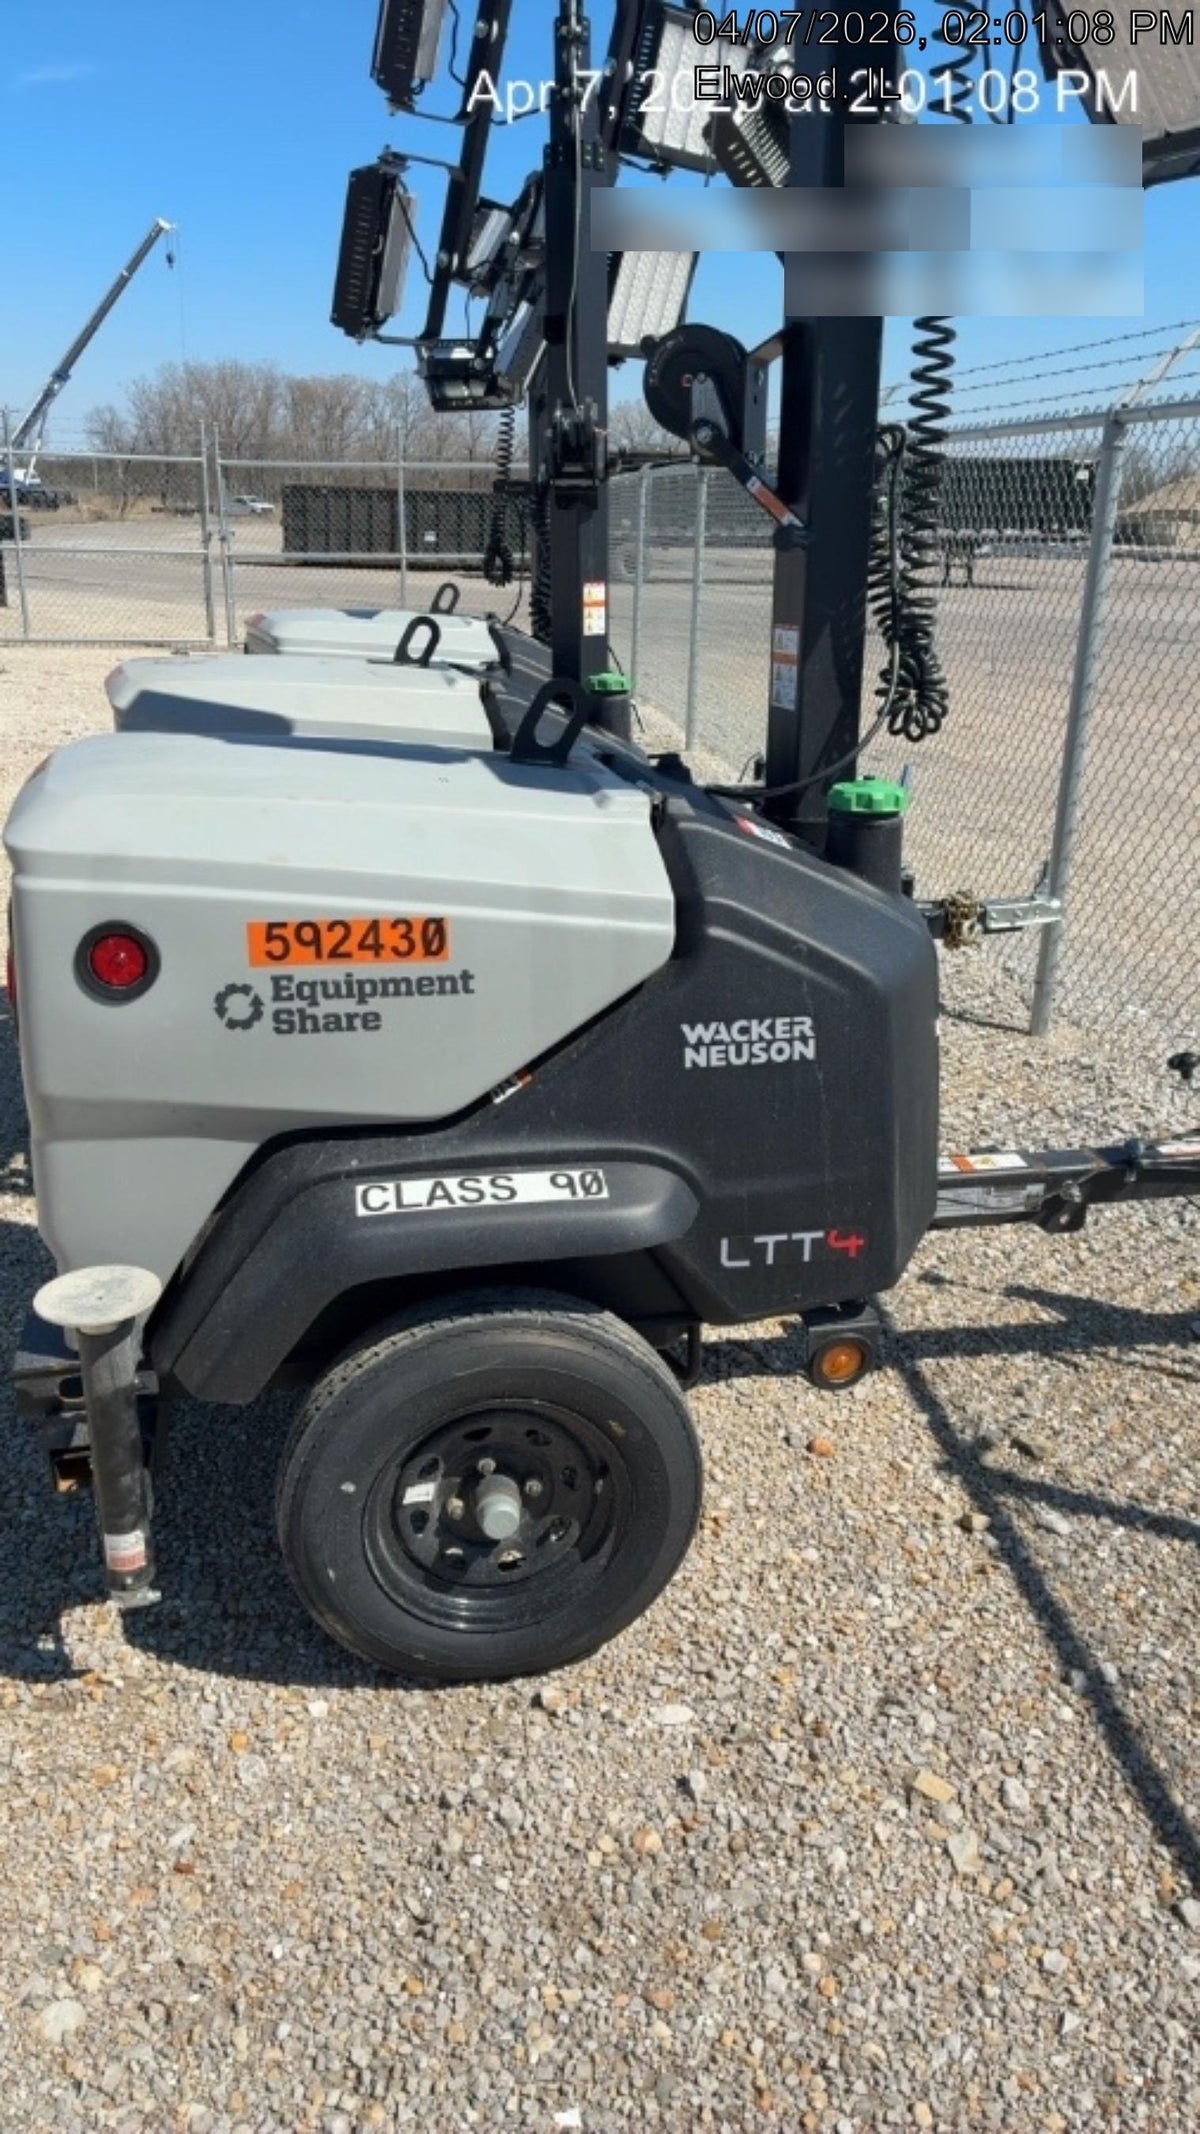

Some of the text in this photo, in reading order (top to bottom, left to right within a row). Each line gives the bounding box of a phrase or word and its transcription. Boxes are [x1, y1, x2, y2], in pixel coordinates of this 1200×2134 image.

[264, 917, 447, 961] 592430
[270, 969, 475, 1007] Equipment
[271, 1008, 382, 1035] Share
[680, 1016, 816, 1045] WACKER
[684, 1038, 816, 1069] NEUSON
[360, 1170, 604, 1212] CLASS 90
[720, 1229, 864, 1268] LTT4
